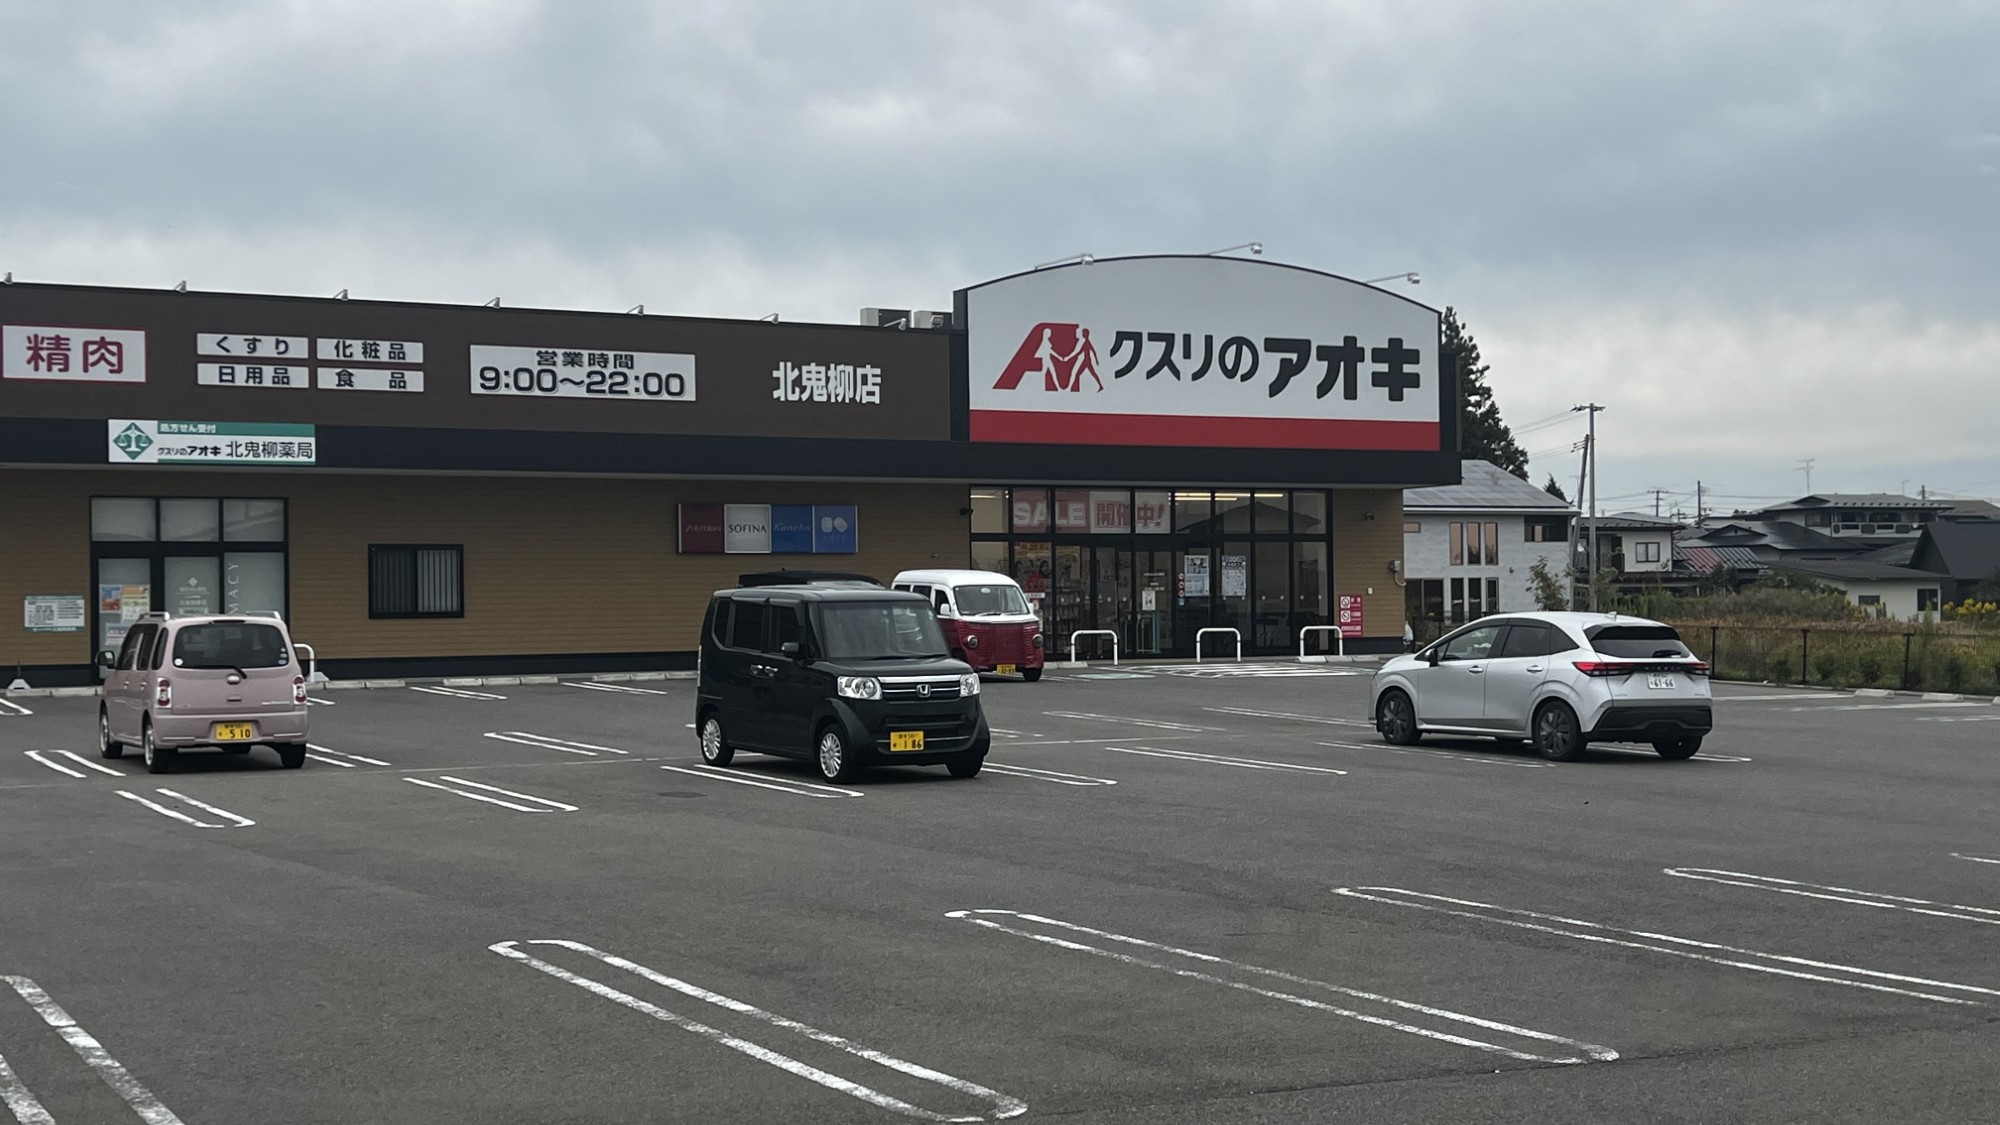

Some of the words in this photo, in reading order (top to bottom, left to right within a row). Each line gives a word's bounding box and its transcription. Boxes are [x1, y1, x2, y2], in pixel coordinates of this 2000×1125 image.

[26, 332, 125, 375] 精肉
[215, 336, 290, 356] くすり
[334, 339, 407, 361] 化粧品
[536, 349, 634, 370] 営業時間
[1109, 329, 1421, 402] クスリのアオキ
[217, 366, 291, 386] 日用品
[771, 360, 882, 405] 北鬼柳店
[159, 423, 217, 434] 処方せん受付
[158, 445, 222, 457] クスリのアオキ
[225, 440, 313, 459] 北鬼柳薬局
[1013, 500, 1086, 527] SALE
[728, 523, 767, 534] SOFINA
